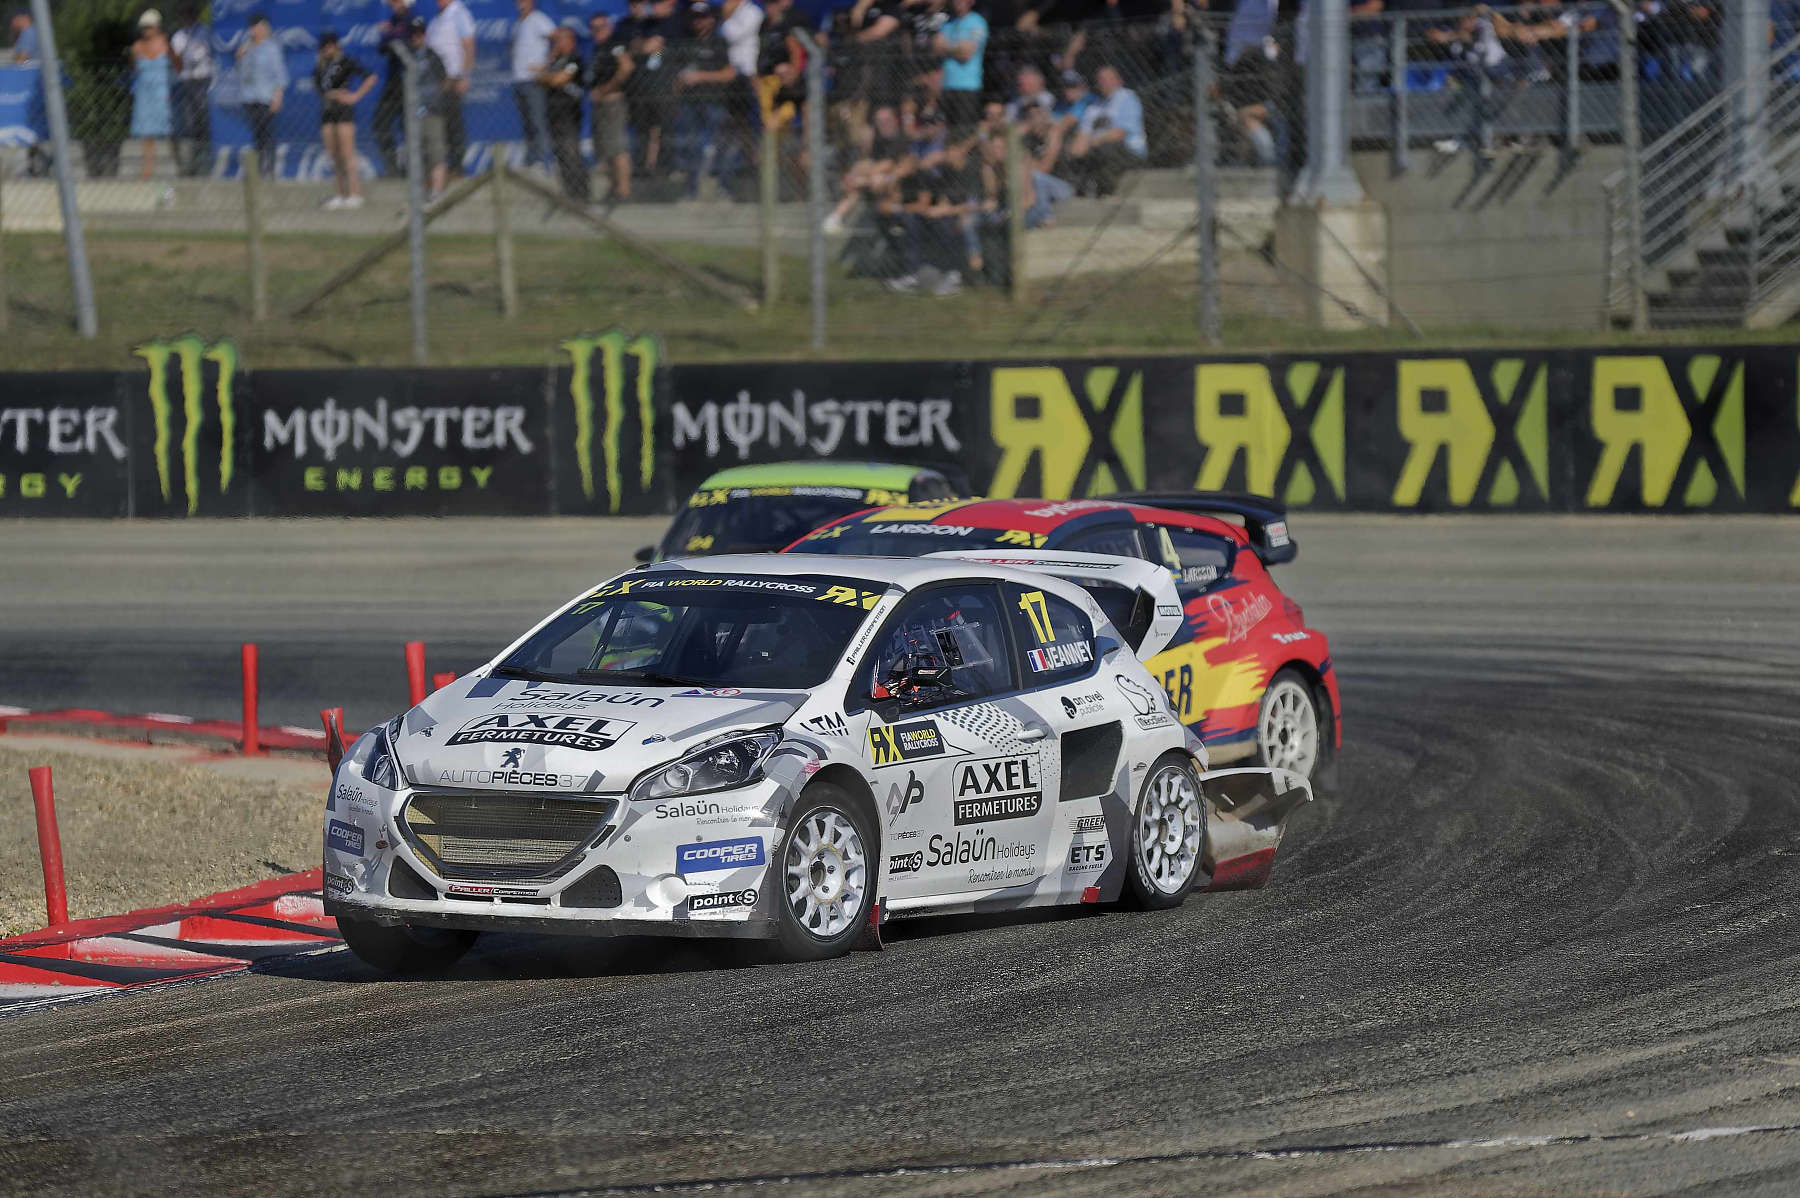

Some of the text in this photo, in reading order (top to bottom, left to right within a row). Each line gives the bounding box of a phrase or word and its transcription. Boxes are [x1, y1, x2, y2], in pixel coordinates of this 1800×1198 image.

[0, 406, 128, 460] TER
[263, 398, 534, 461] MONSTER
[671, 389, 961, 459] MONSTER
[304, 466, 493, 490] ENERGY
[870, 523, 976, 537] LARSSON
[1159, 526, 1182, 571] 4
[641, 579, 817, 594] FIA WORLD RALLYCROSS
[1018, 590, 1056, 644] 17
[1045, 640, 1095, 670] JEANNEY
[492, 701, 589, 710] Holidays
[510, 688, 665, 708] Salaün
[468, 713, 615, 738] AXEL
[456, 729, 606, 749] FERMETURES
[903, 737, 939, 751] RALLYCROSS
[958, 757, 1038, 797] AXEL
[655, 800, 720, 819] Salaün
[958, 795, 1039, 820] FERMETURES
[331, 825, 363, 843] COOPER
[683, 843, 758, 861] COOPER
[720, 853, 757, 863] TIRES
[926, 828, 1036, 867] Salaün Holidays
[1071, 844, 1106, 864] ETS
